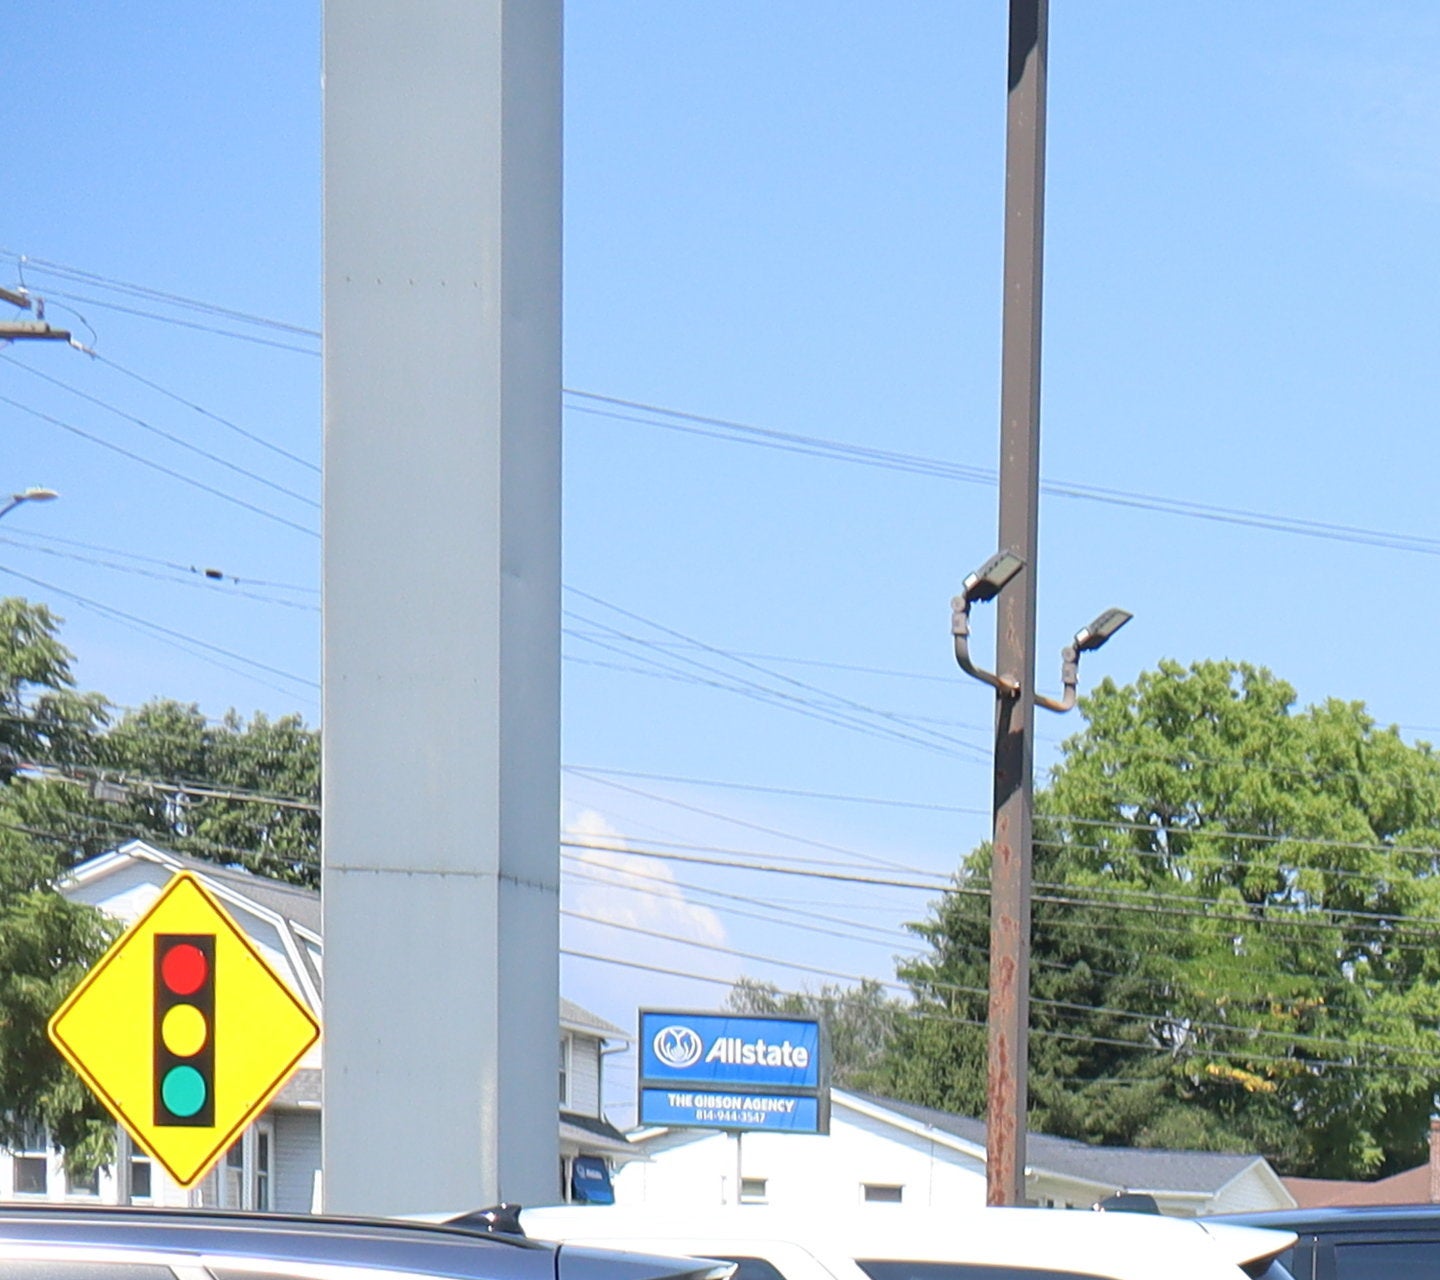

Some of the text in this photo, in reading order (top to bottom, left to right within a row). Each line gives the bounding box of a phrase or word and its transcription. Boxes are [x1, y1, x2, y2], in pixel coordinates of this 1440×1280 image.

[705, 1036, 810, 1068] Allstate
[667, 1093, 795, 1114] THE GIBSON AGENCY
